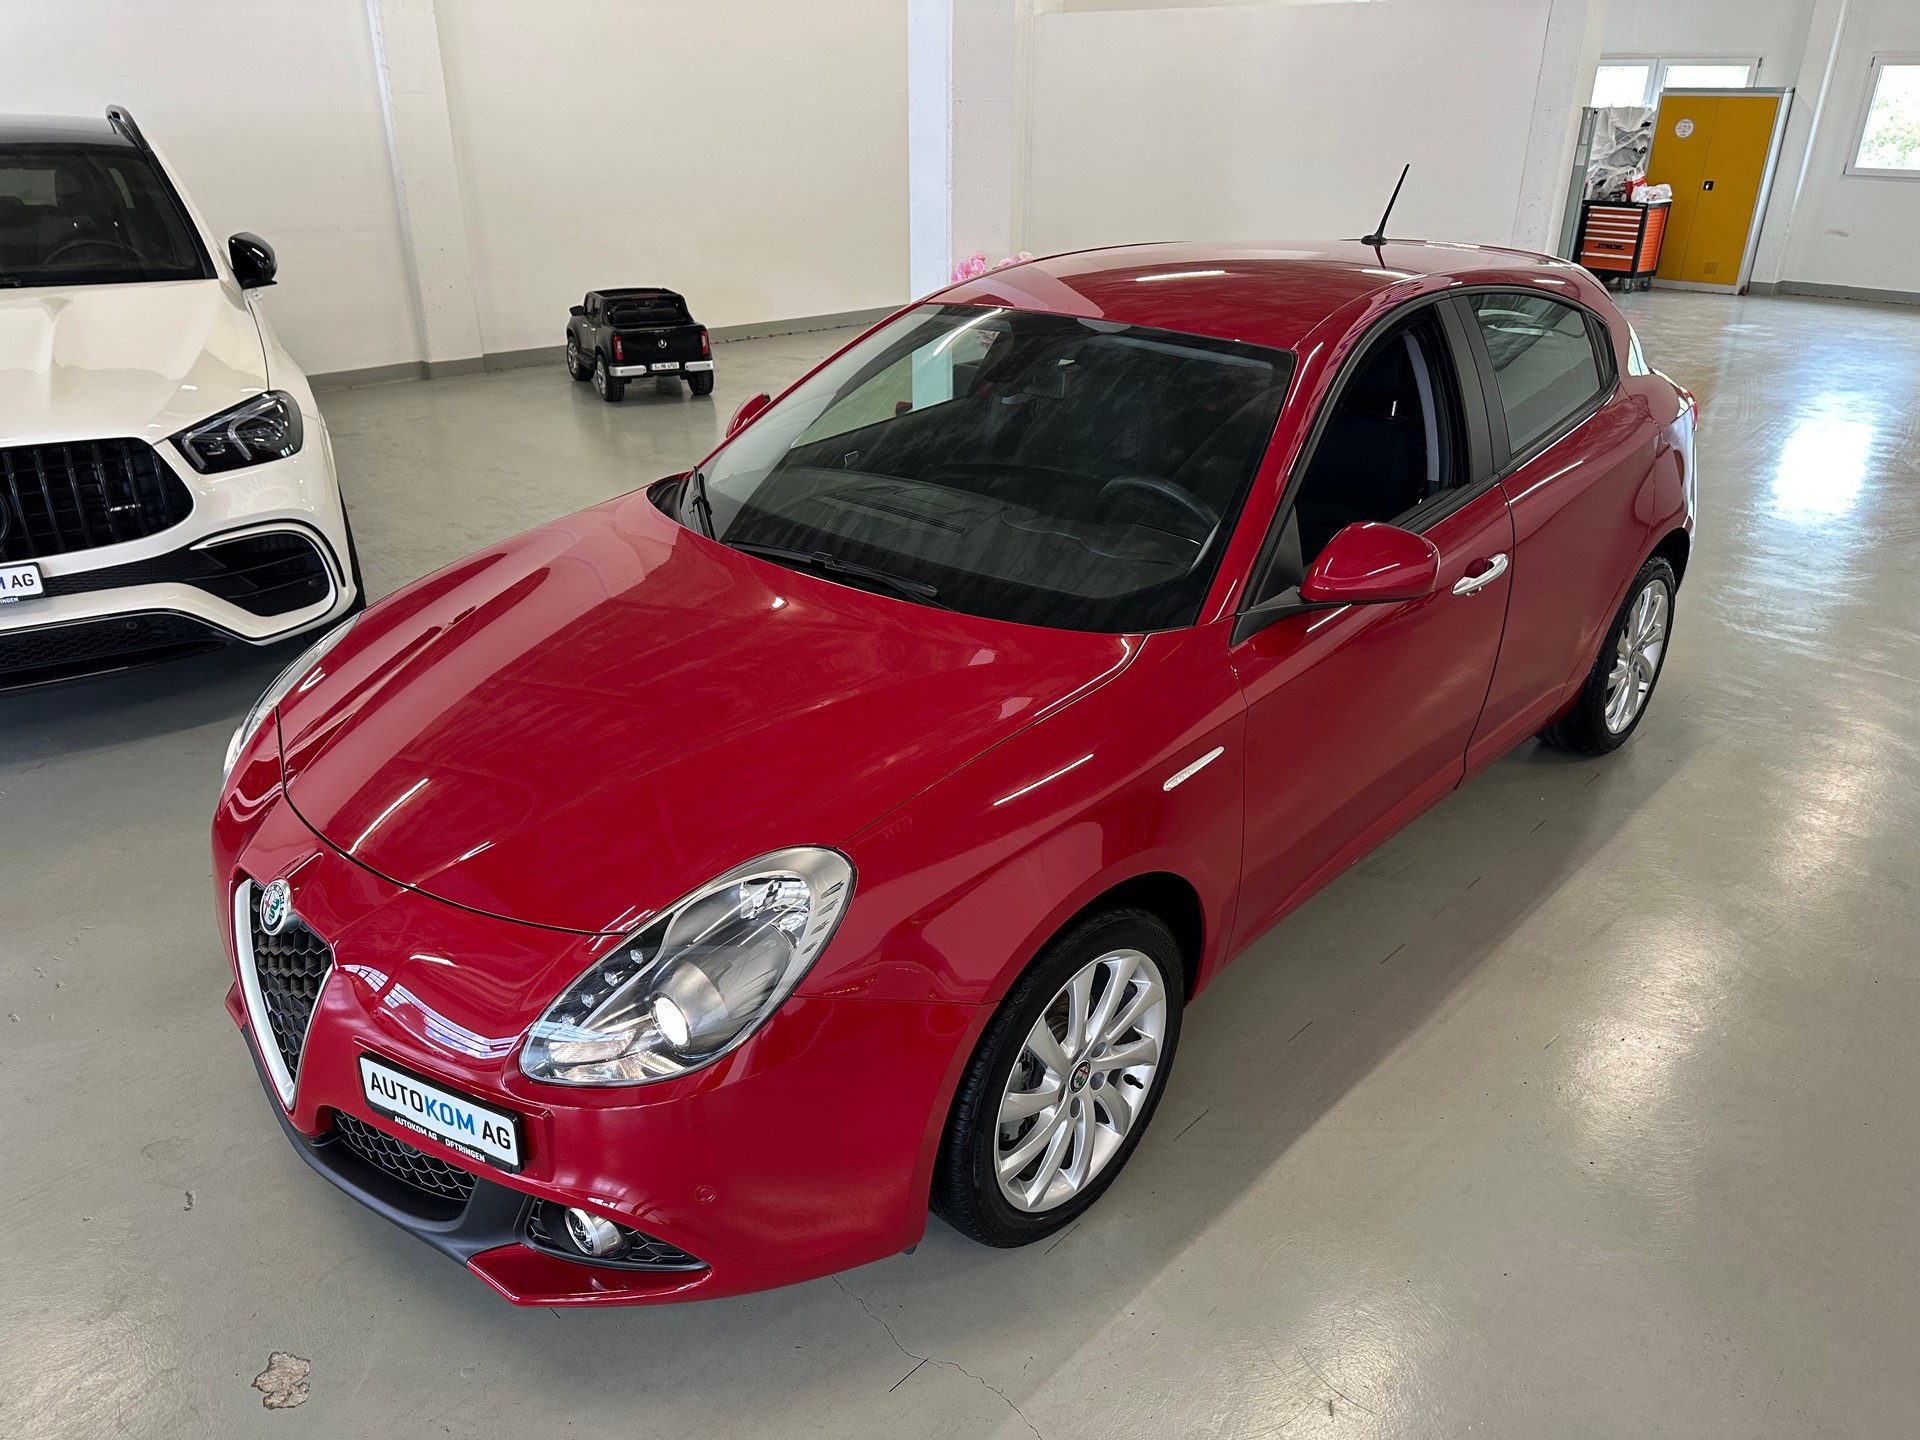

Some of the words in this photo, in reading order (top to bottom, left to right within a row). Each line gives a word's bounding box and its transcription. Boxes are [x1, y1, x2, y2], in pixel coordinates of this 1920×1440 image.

[12, 573, 34, 588] AG
[371, 1072, 475, 1135] AUTOKOM
[482, 1120, 511, 1150] AG
[394, 1115, 427, 1136] AUTOKOM
[428, 1130, 438, 1141] AG
[445, 1138, 486, 1163] OFTRINGEN
